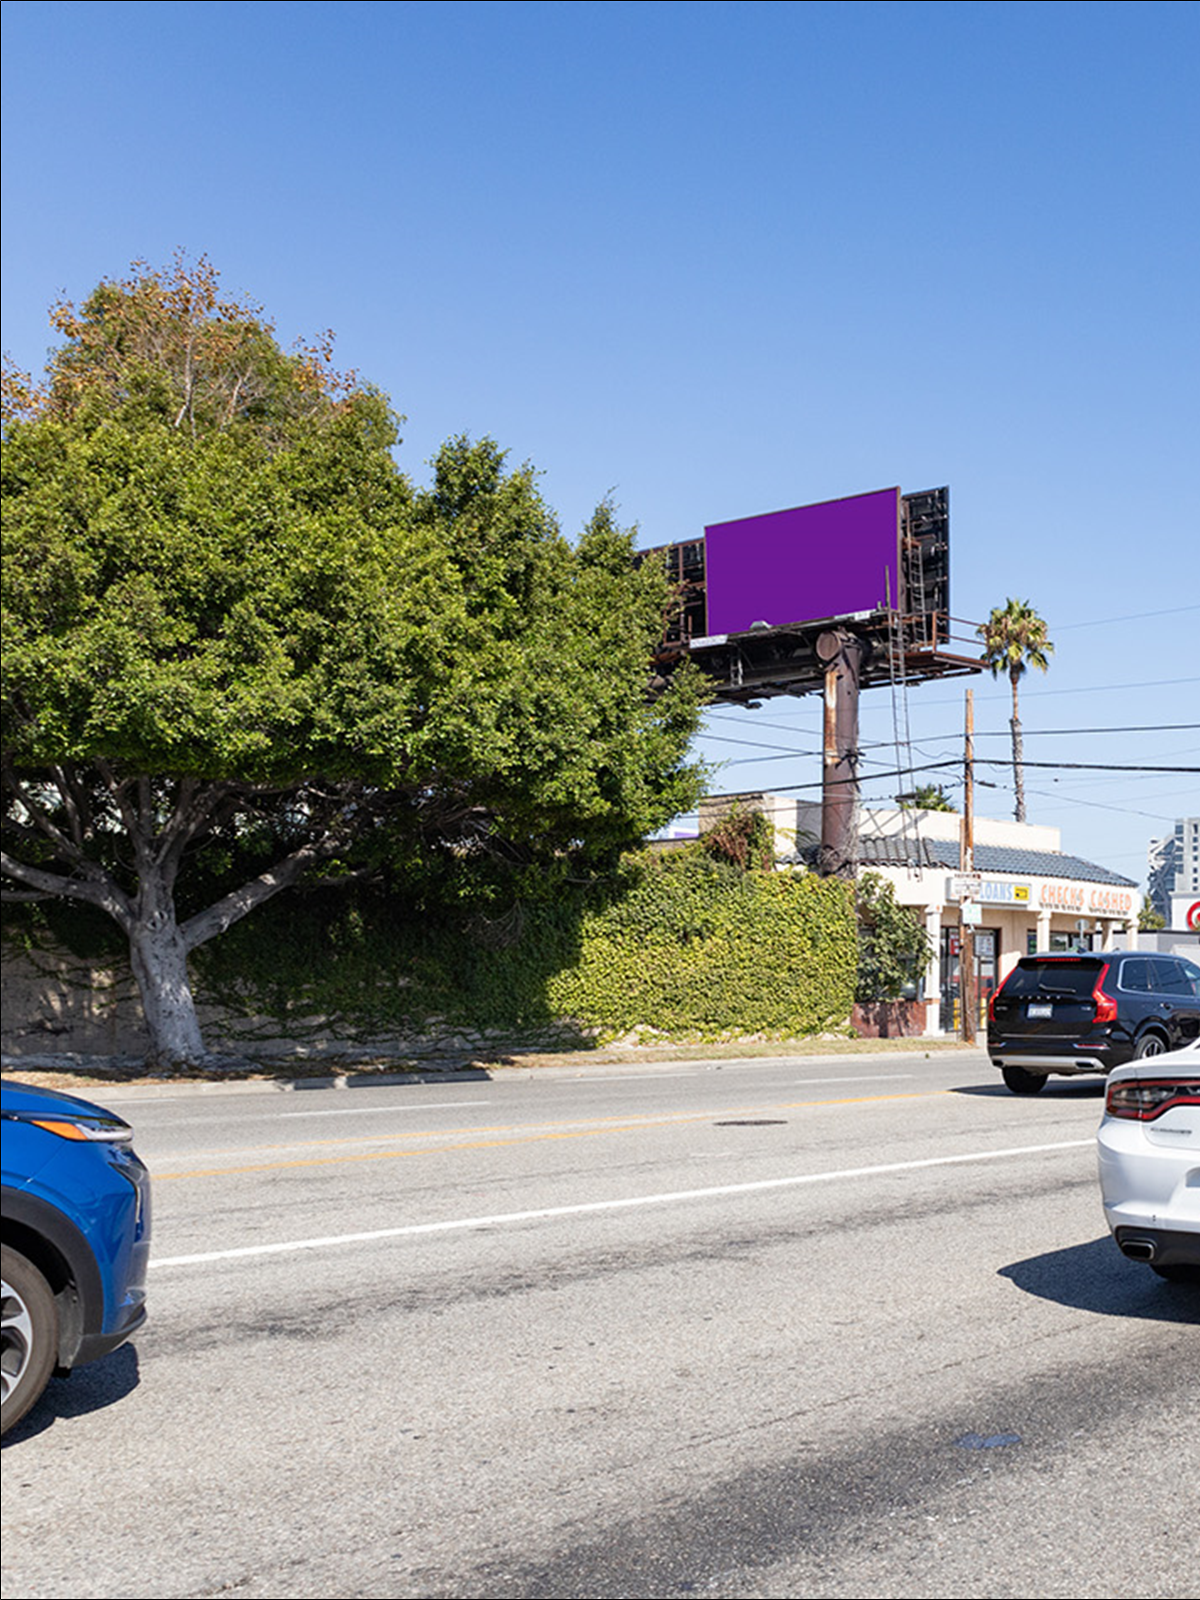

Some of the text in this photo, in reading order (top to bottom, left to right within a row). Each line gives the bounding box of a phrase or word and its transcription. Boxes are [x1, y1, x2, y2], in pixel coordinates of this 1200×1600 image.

[980, 883, 1013, 900] LOANS
[1041, 884, 1132, 911] CHECKS CASHED
